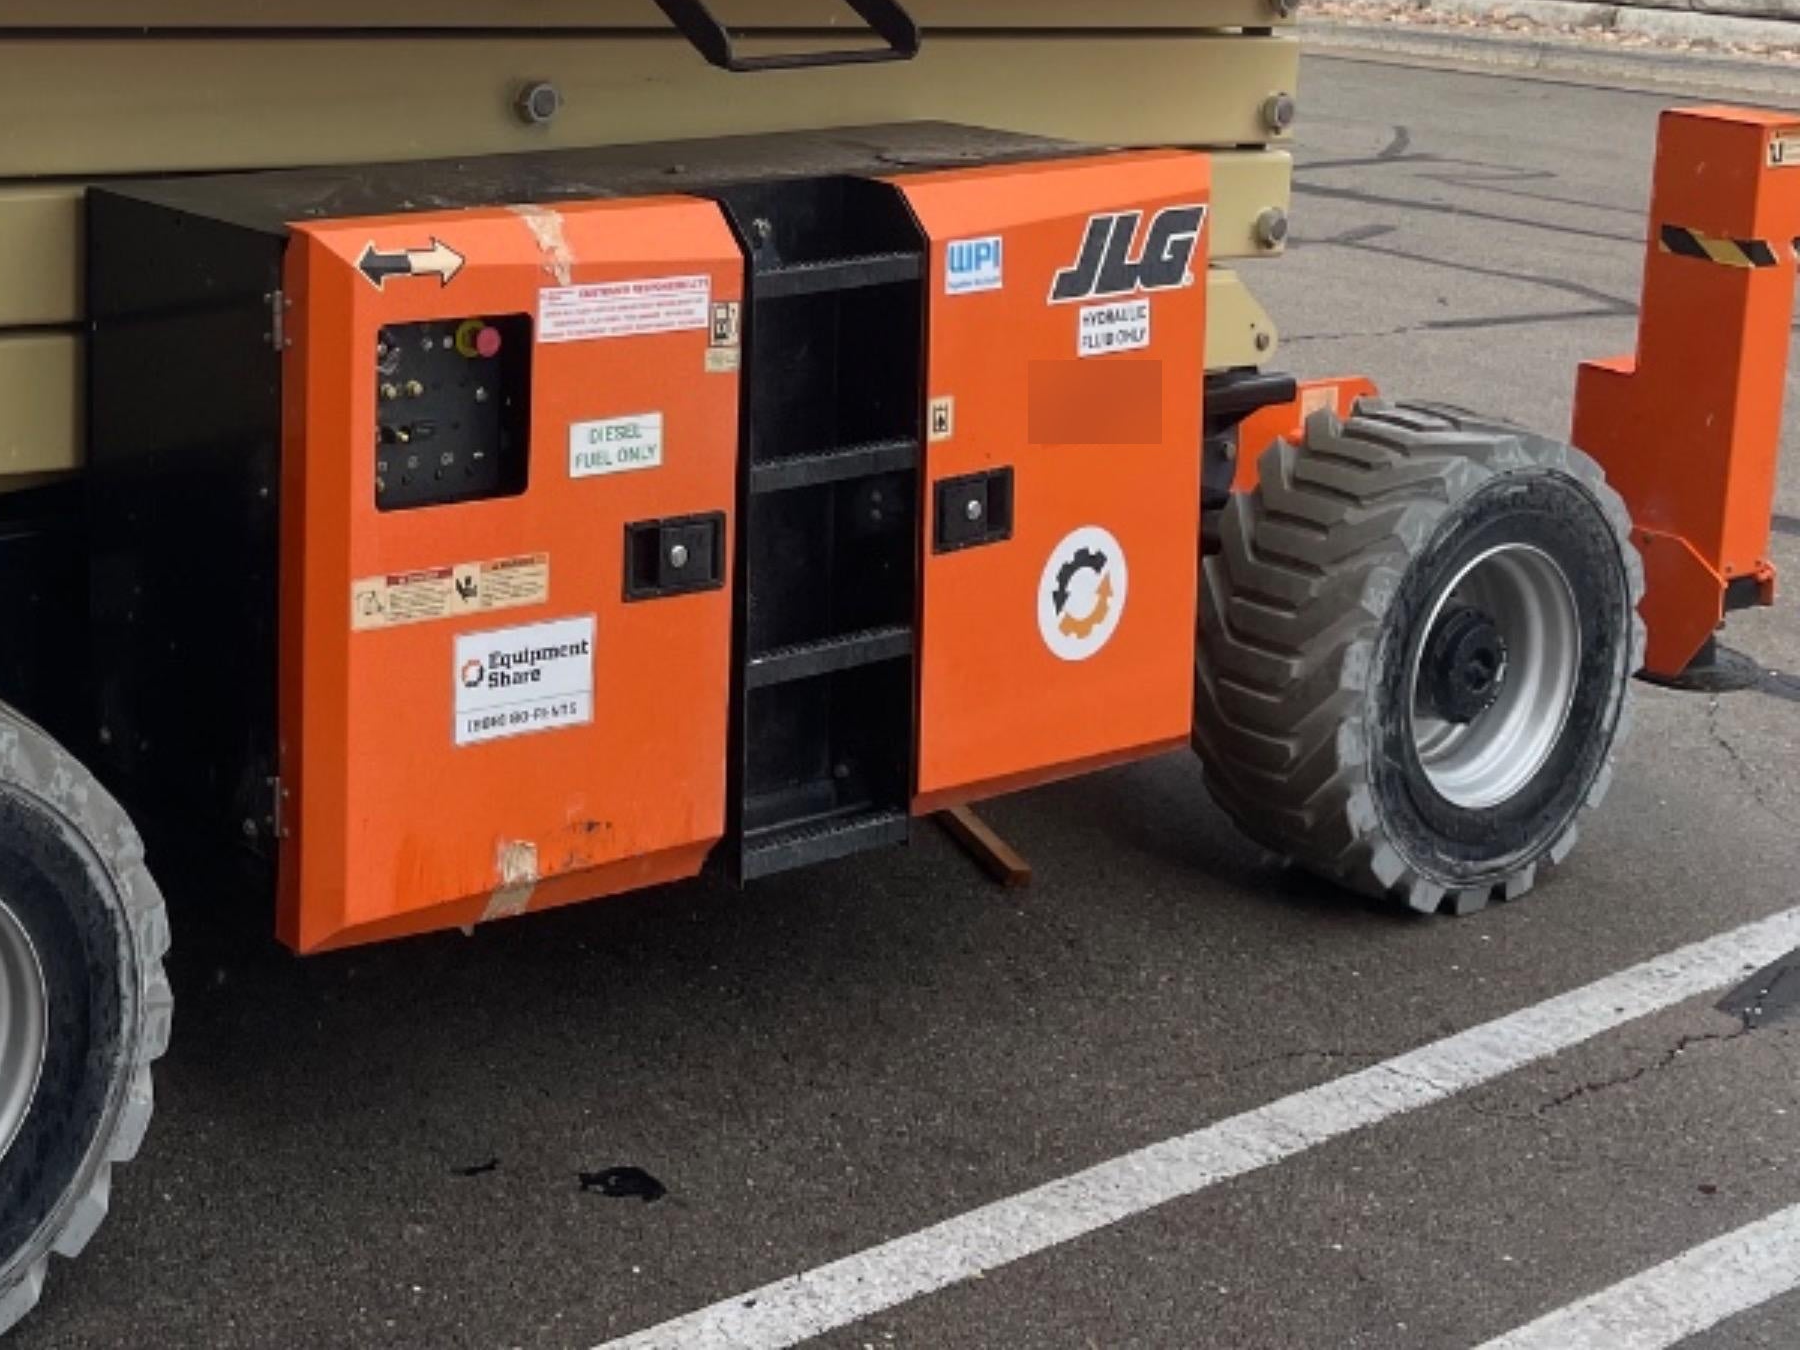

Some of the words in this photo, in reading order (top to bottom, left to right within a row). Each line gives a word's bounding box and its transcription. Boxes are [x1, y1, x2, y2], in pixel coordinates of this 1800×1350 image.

[1046, 204, 1207, 305] JLG
[589, 423, 642, 445] DIESEL
[575, 450, 613, 468] FUEL
[617, 444, 657, 463] ONLY
[488, 639, 589, 669] Equipment
[488, 667, 541, 688] Share
